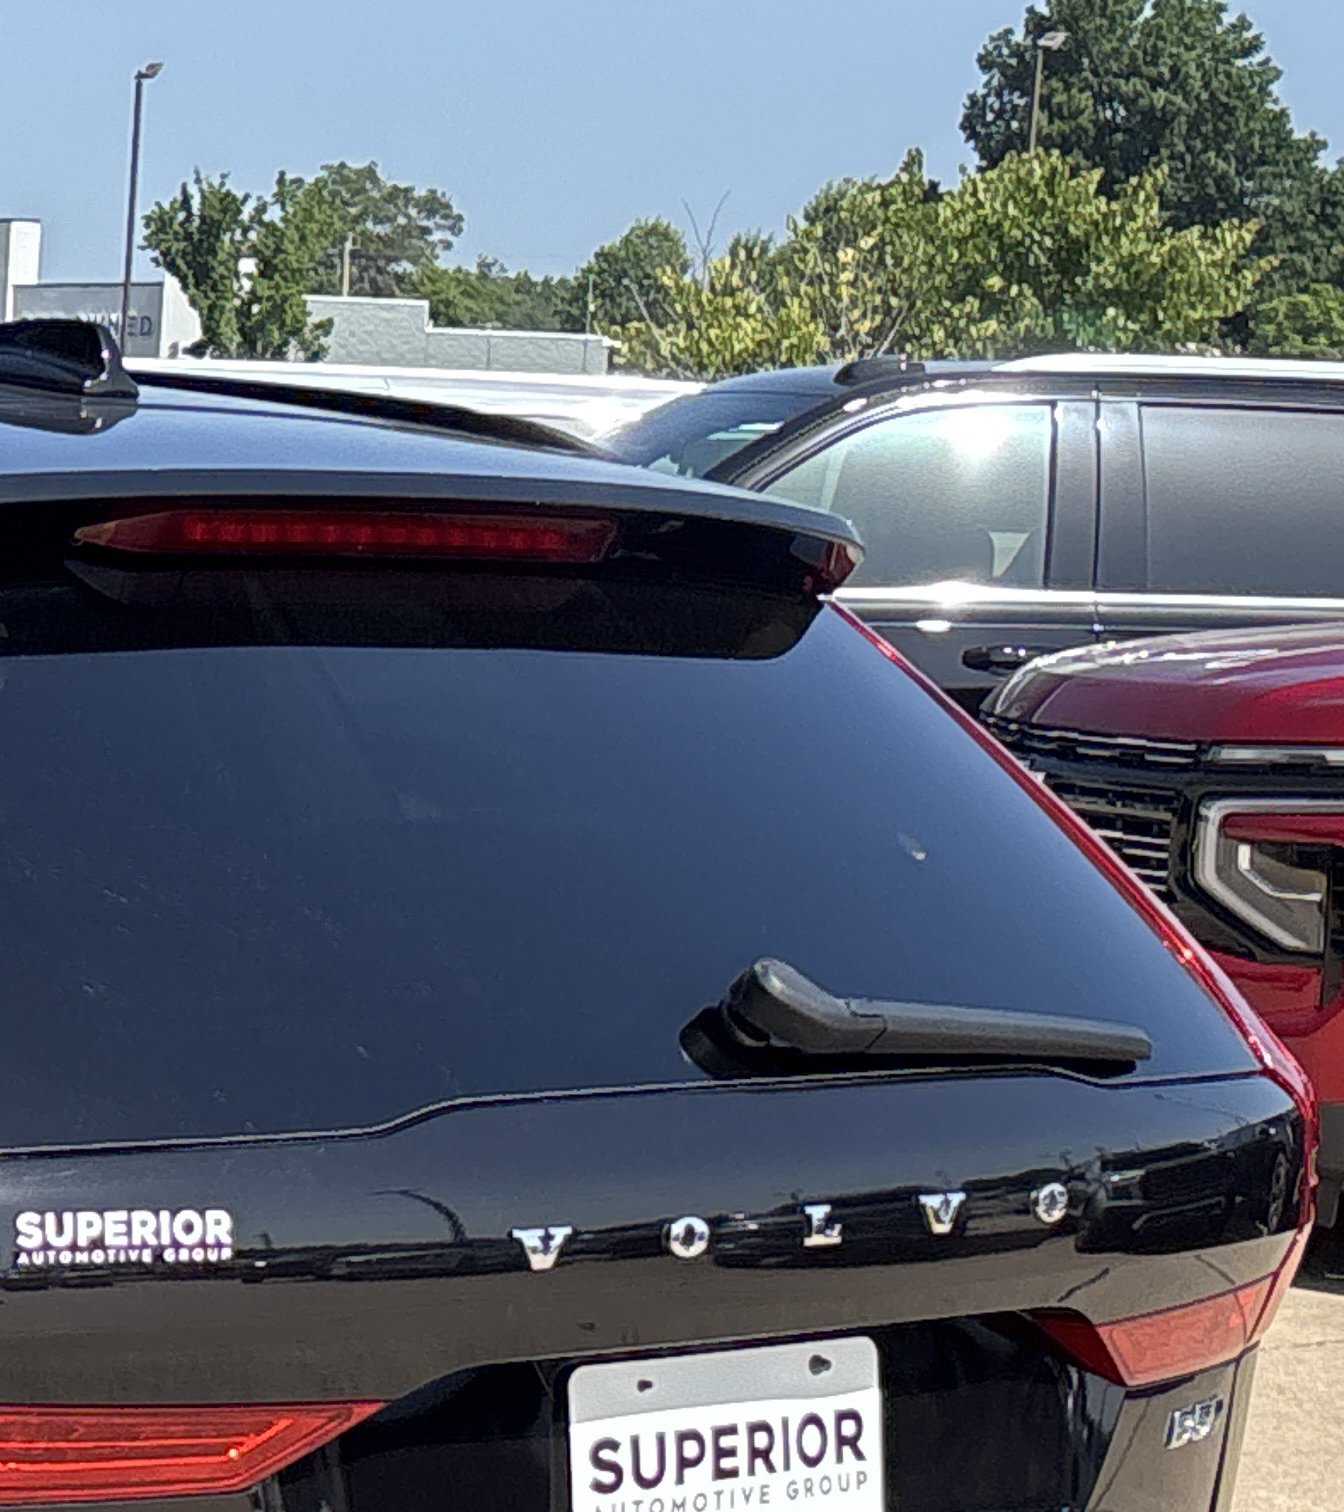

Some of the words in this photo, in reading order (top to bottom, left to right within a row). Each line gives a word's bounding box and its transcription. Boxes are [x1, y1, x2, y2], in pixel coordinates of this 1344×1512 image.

[15, 1209, 233, 1249] SUPERIOR
[512, 1182, 1069, 1272] VOLVO
[16, 1249, 152, 1266] AUTOMOTIVE
[162, 1247, 233, 1263] GROUP
[589, 1408, 867, 1494] SUPERIOR
[786, 1470, 868, 1501] GROUP
